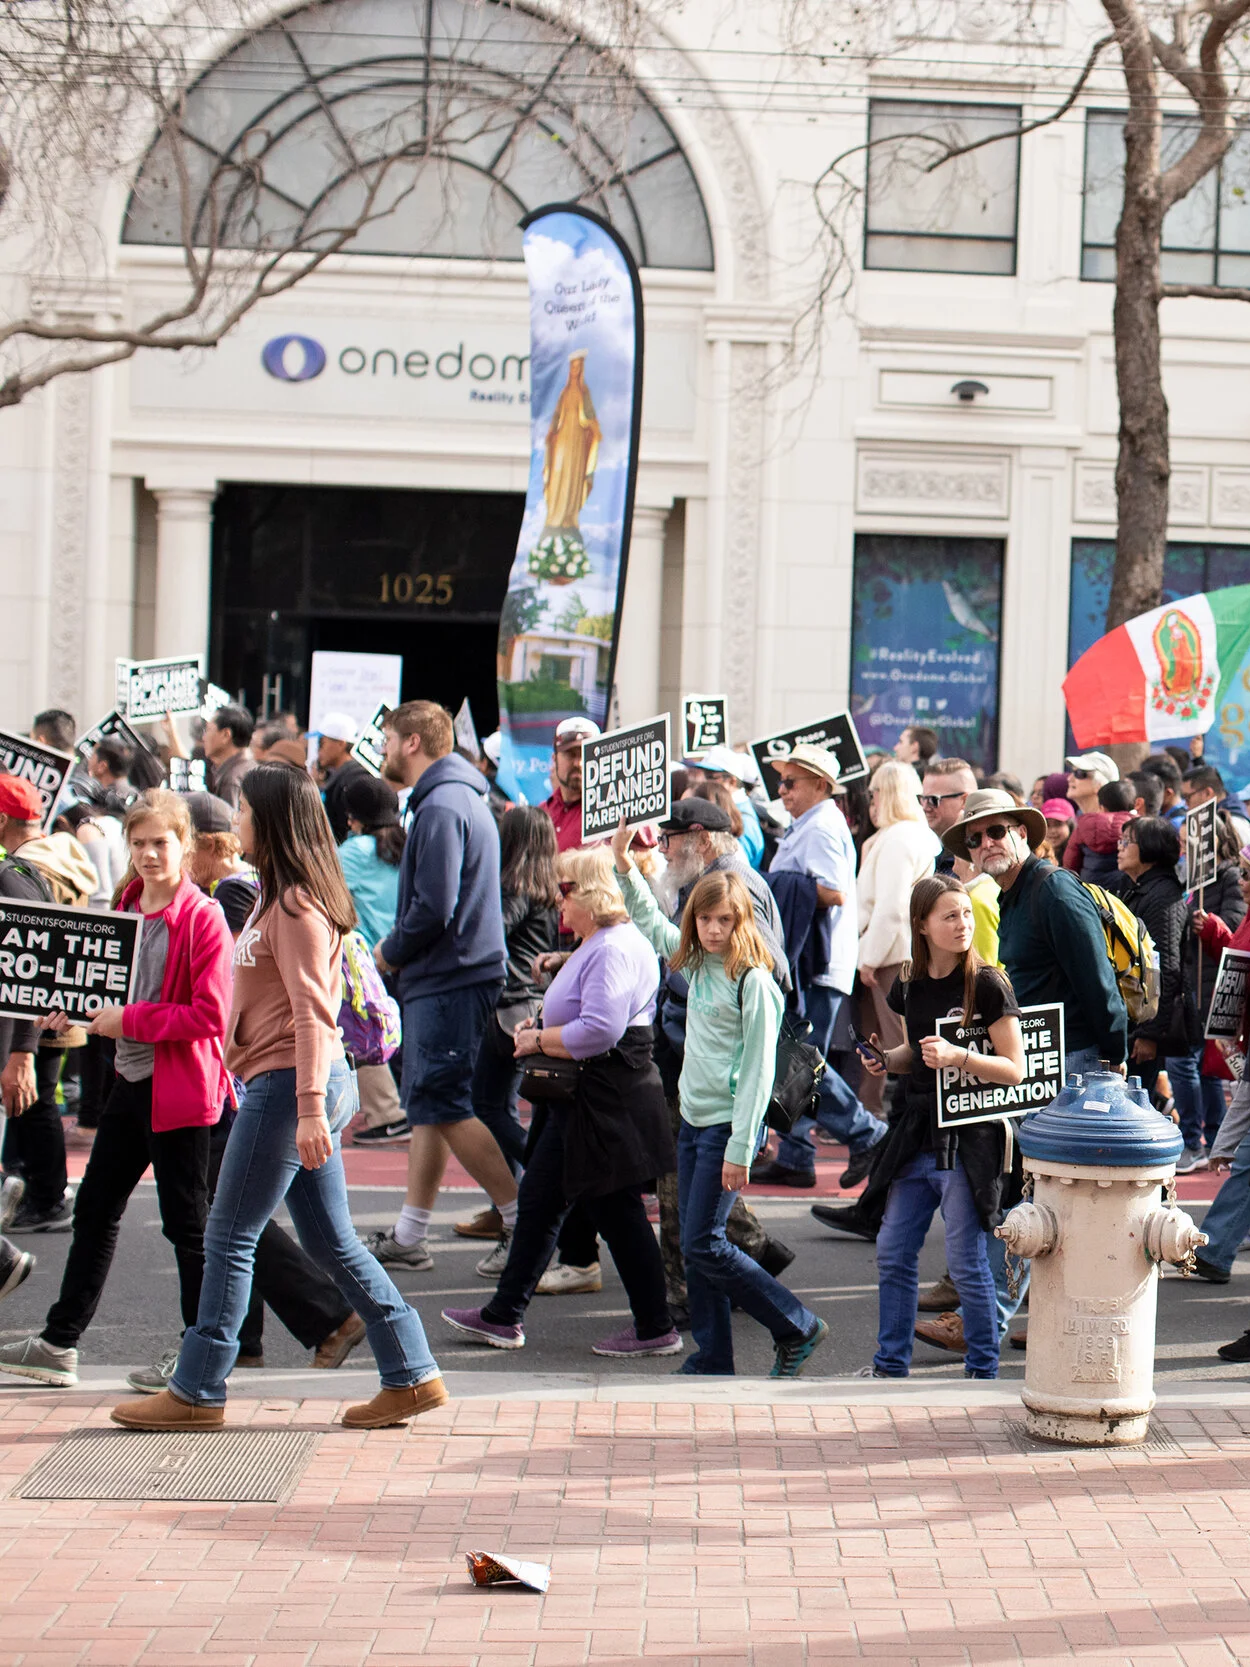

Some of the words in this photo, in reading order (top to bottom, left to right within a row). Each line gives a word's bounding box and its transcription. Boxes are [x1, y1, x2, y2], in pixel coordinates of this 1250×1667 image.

[380, 572, 453, 605] 1025
[600, 730, 655, 755] STUDENTSFORLIFE.ORG
[585, 740, 665, 789] DEFUND
[585, 768, 665, 812] PLANNED
[585, 793, 665, 830] PARENTHOOD
[6, 912, 116, 935] STUDENTSFORLIFE.ORG
[1, 927, 50, 951] AM
[64, 934, 121, 960] THE
[946, 1080, 1057, 1113] GENERATION
